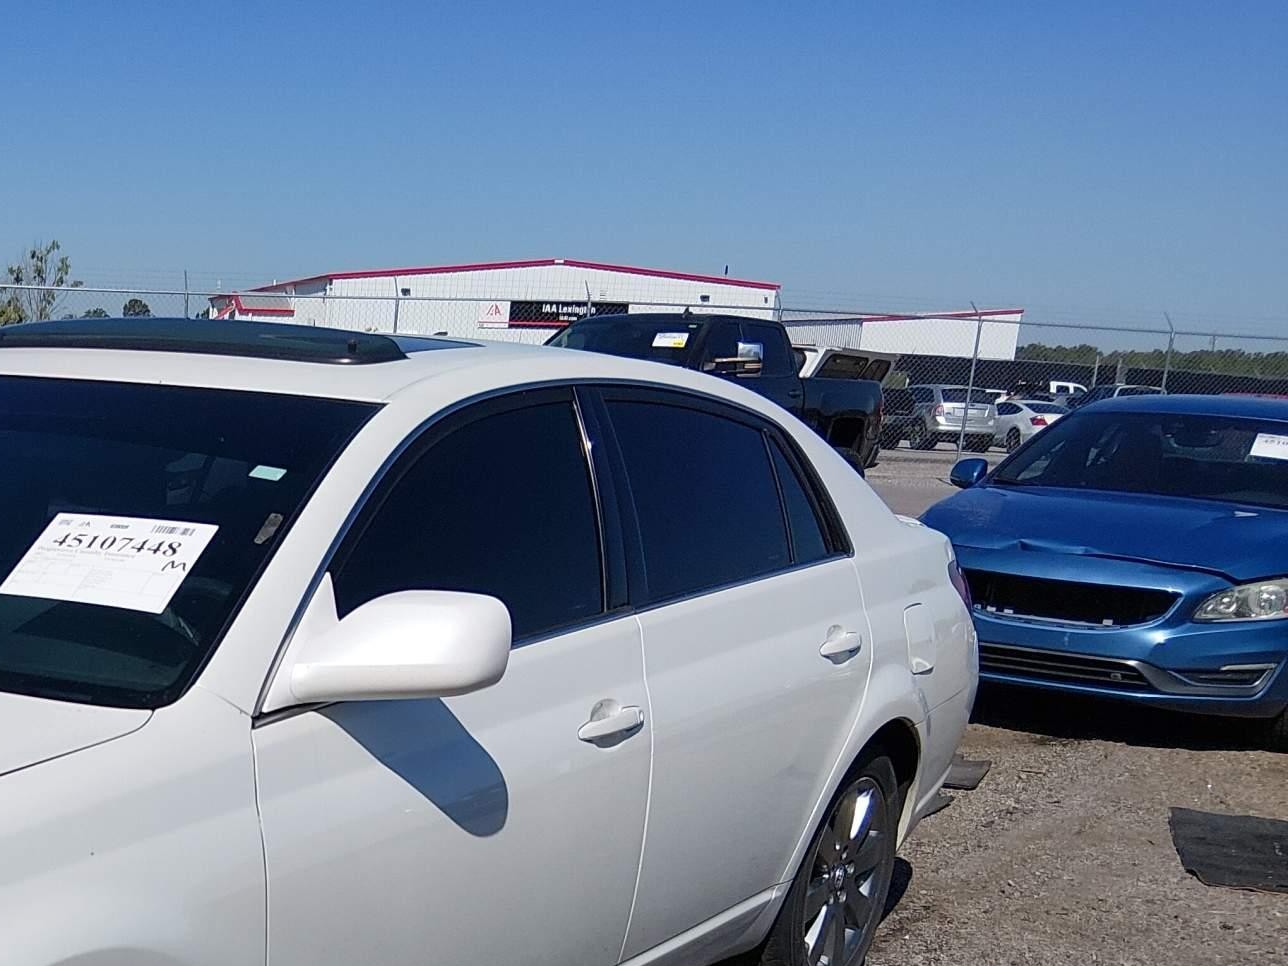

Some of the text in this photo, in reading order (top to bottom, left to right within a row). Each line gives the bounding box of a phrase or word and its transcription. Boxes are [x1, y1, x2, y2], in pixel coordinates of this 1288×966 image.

[542, 303, 596, 315] IAA Lexingtn
[53, 532, 183, 557] 45107448
